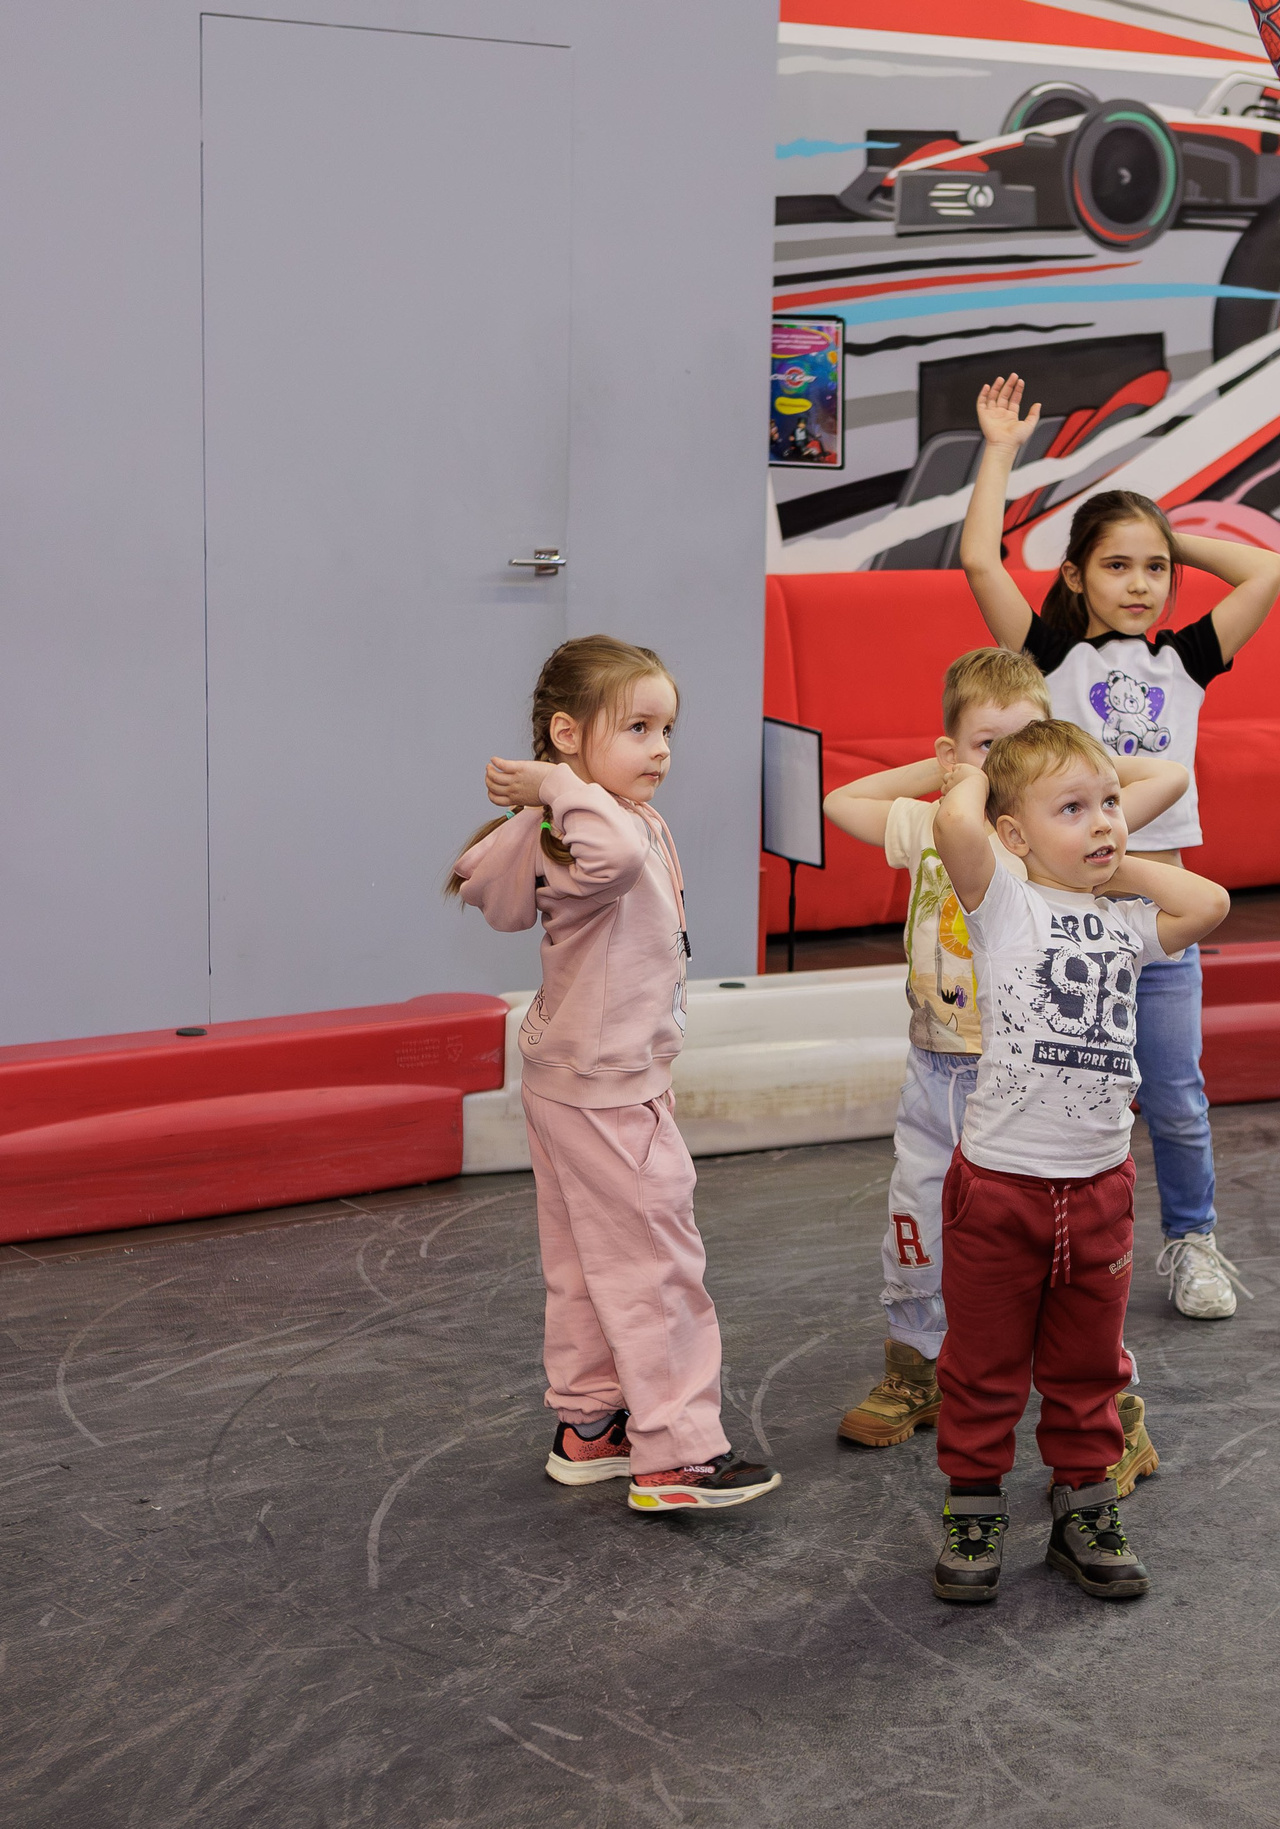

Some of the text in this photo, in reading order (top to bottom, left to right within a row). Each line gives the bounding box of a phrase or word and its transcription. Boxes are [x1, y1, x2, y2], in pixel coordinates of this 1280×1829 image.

[1049, 947, 1137, 1046] 98
[1038, 1046, 1070, 1062] NEW
[1077, 1051, 1109, 1068] YORK
[892, 1212, 934, 1268] R
